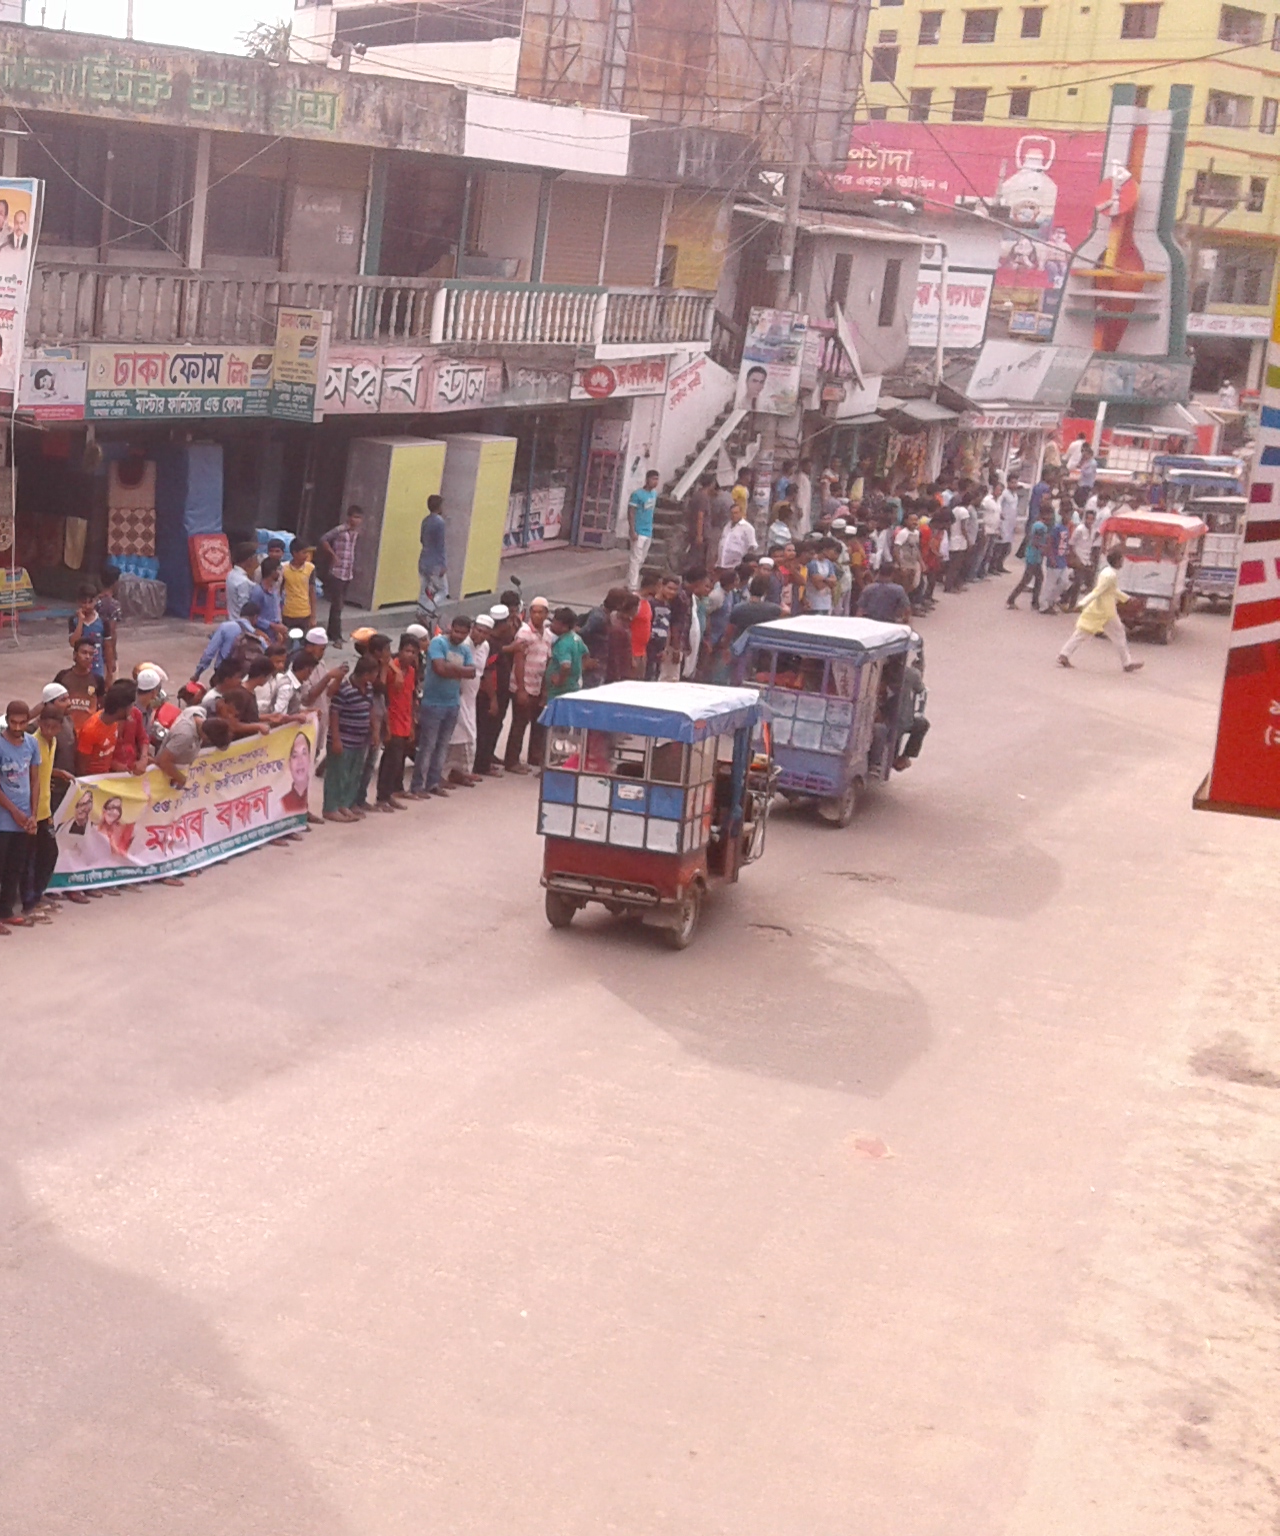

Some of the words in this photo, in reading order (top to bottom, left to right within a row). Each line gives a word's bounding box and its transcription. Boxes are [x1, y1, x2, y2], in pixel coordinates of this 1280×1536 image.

[114, 350, 170, 386] ঢাকা
[170, 352, 223, 384] ফোম
[70, 697, 91, 707] ATAR
[145, 807, 209, 858] মানব
[214, 785, 273, 833] বন্ধন
